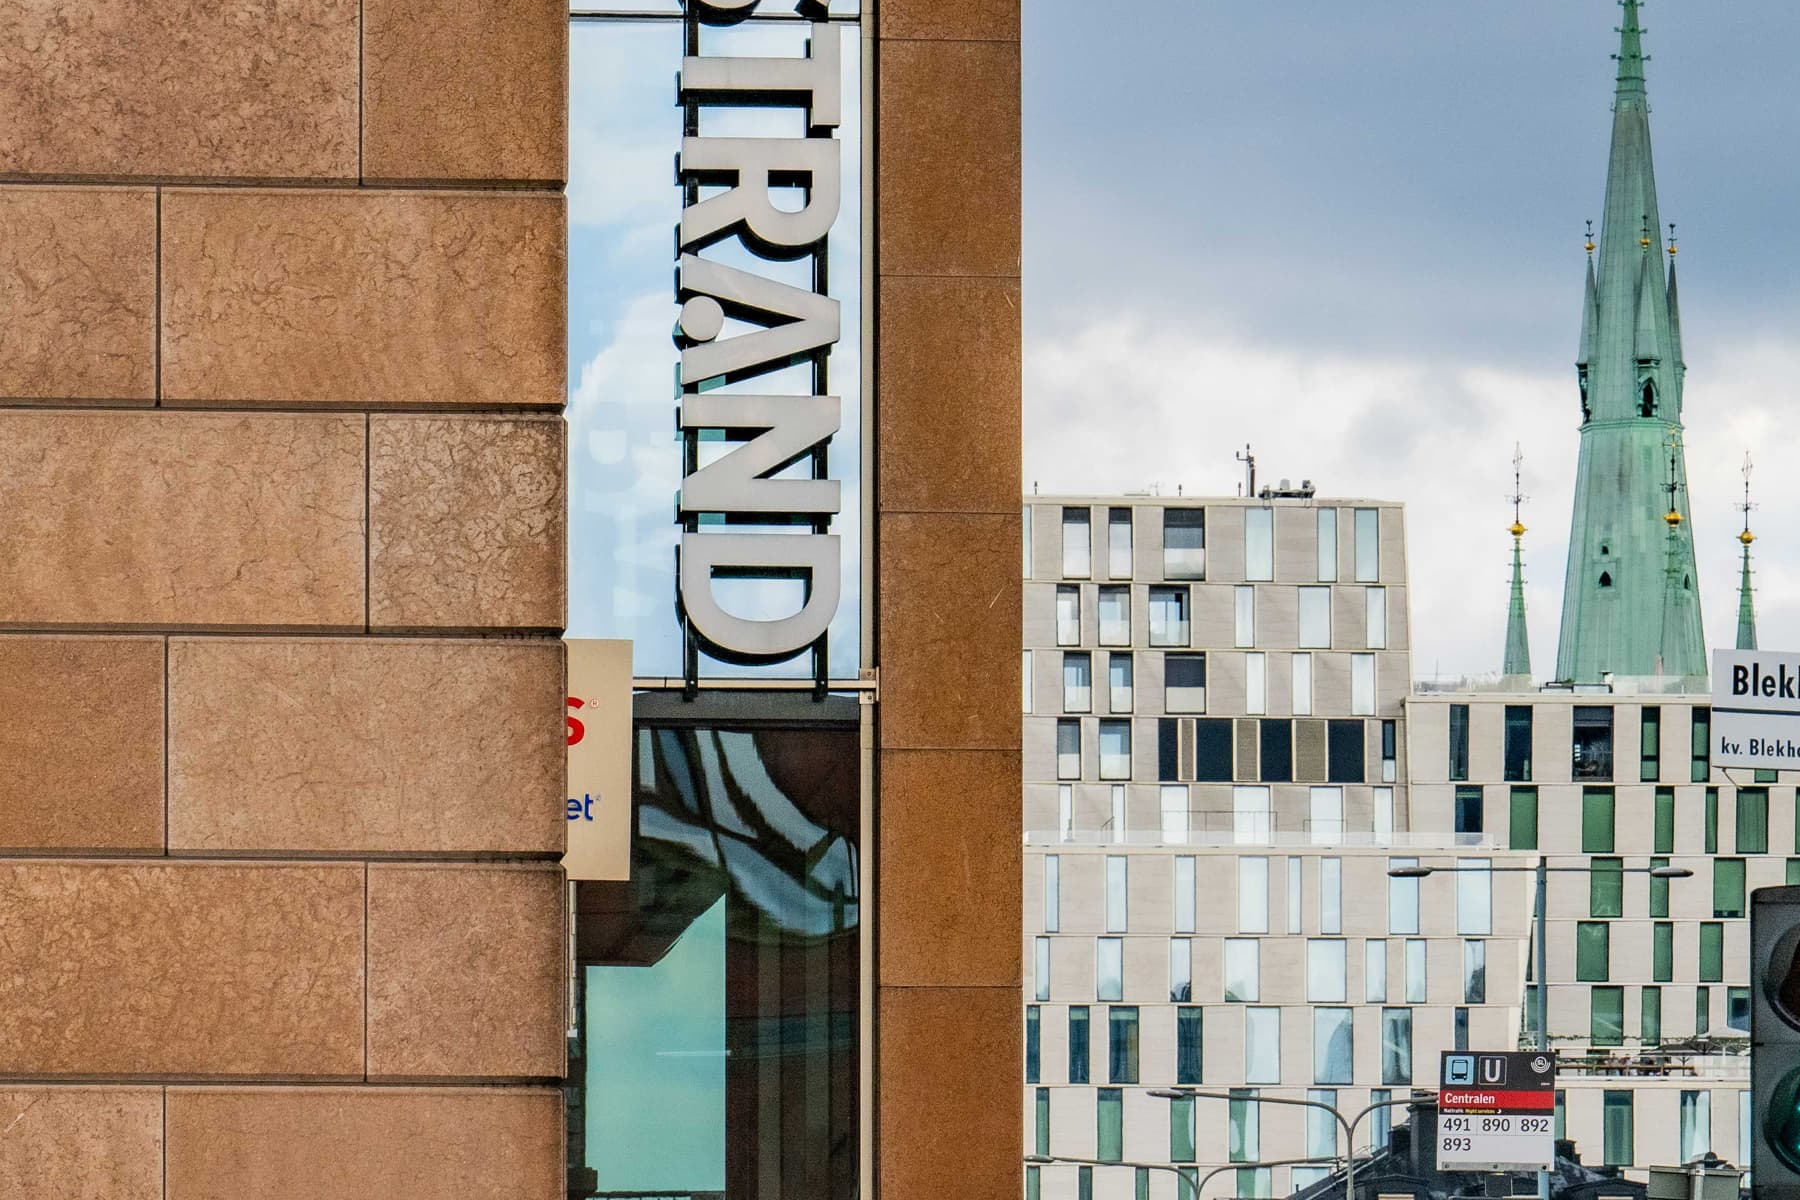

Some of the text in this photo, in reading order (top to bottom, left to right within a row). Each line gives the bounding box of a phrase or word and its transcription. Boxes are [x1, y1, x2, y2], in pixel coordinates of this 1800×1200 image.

[1721, 736, 1743, 755] kv.
[1484, 1059, 1501, 1082] U
[1444, 1092, 1495, 1104] Centralen
[1443, 1118, 1549, 1132] 491 890 892
[1443, 1137, 1472, 1151] 893
